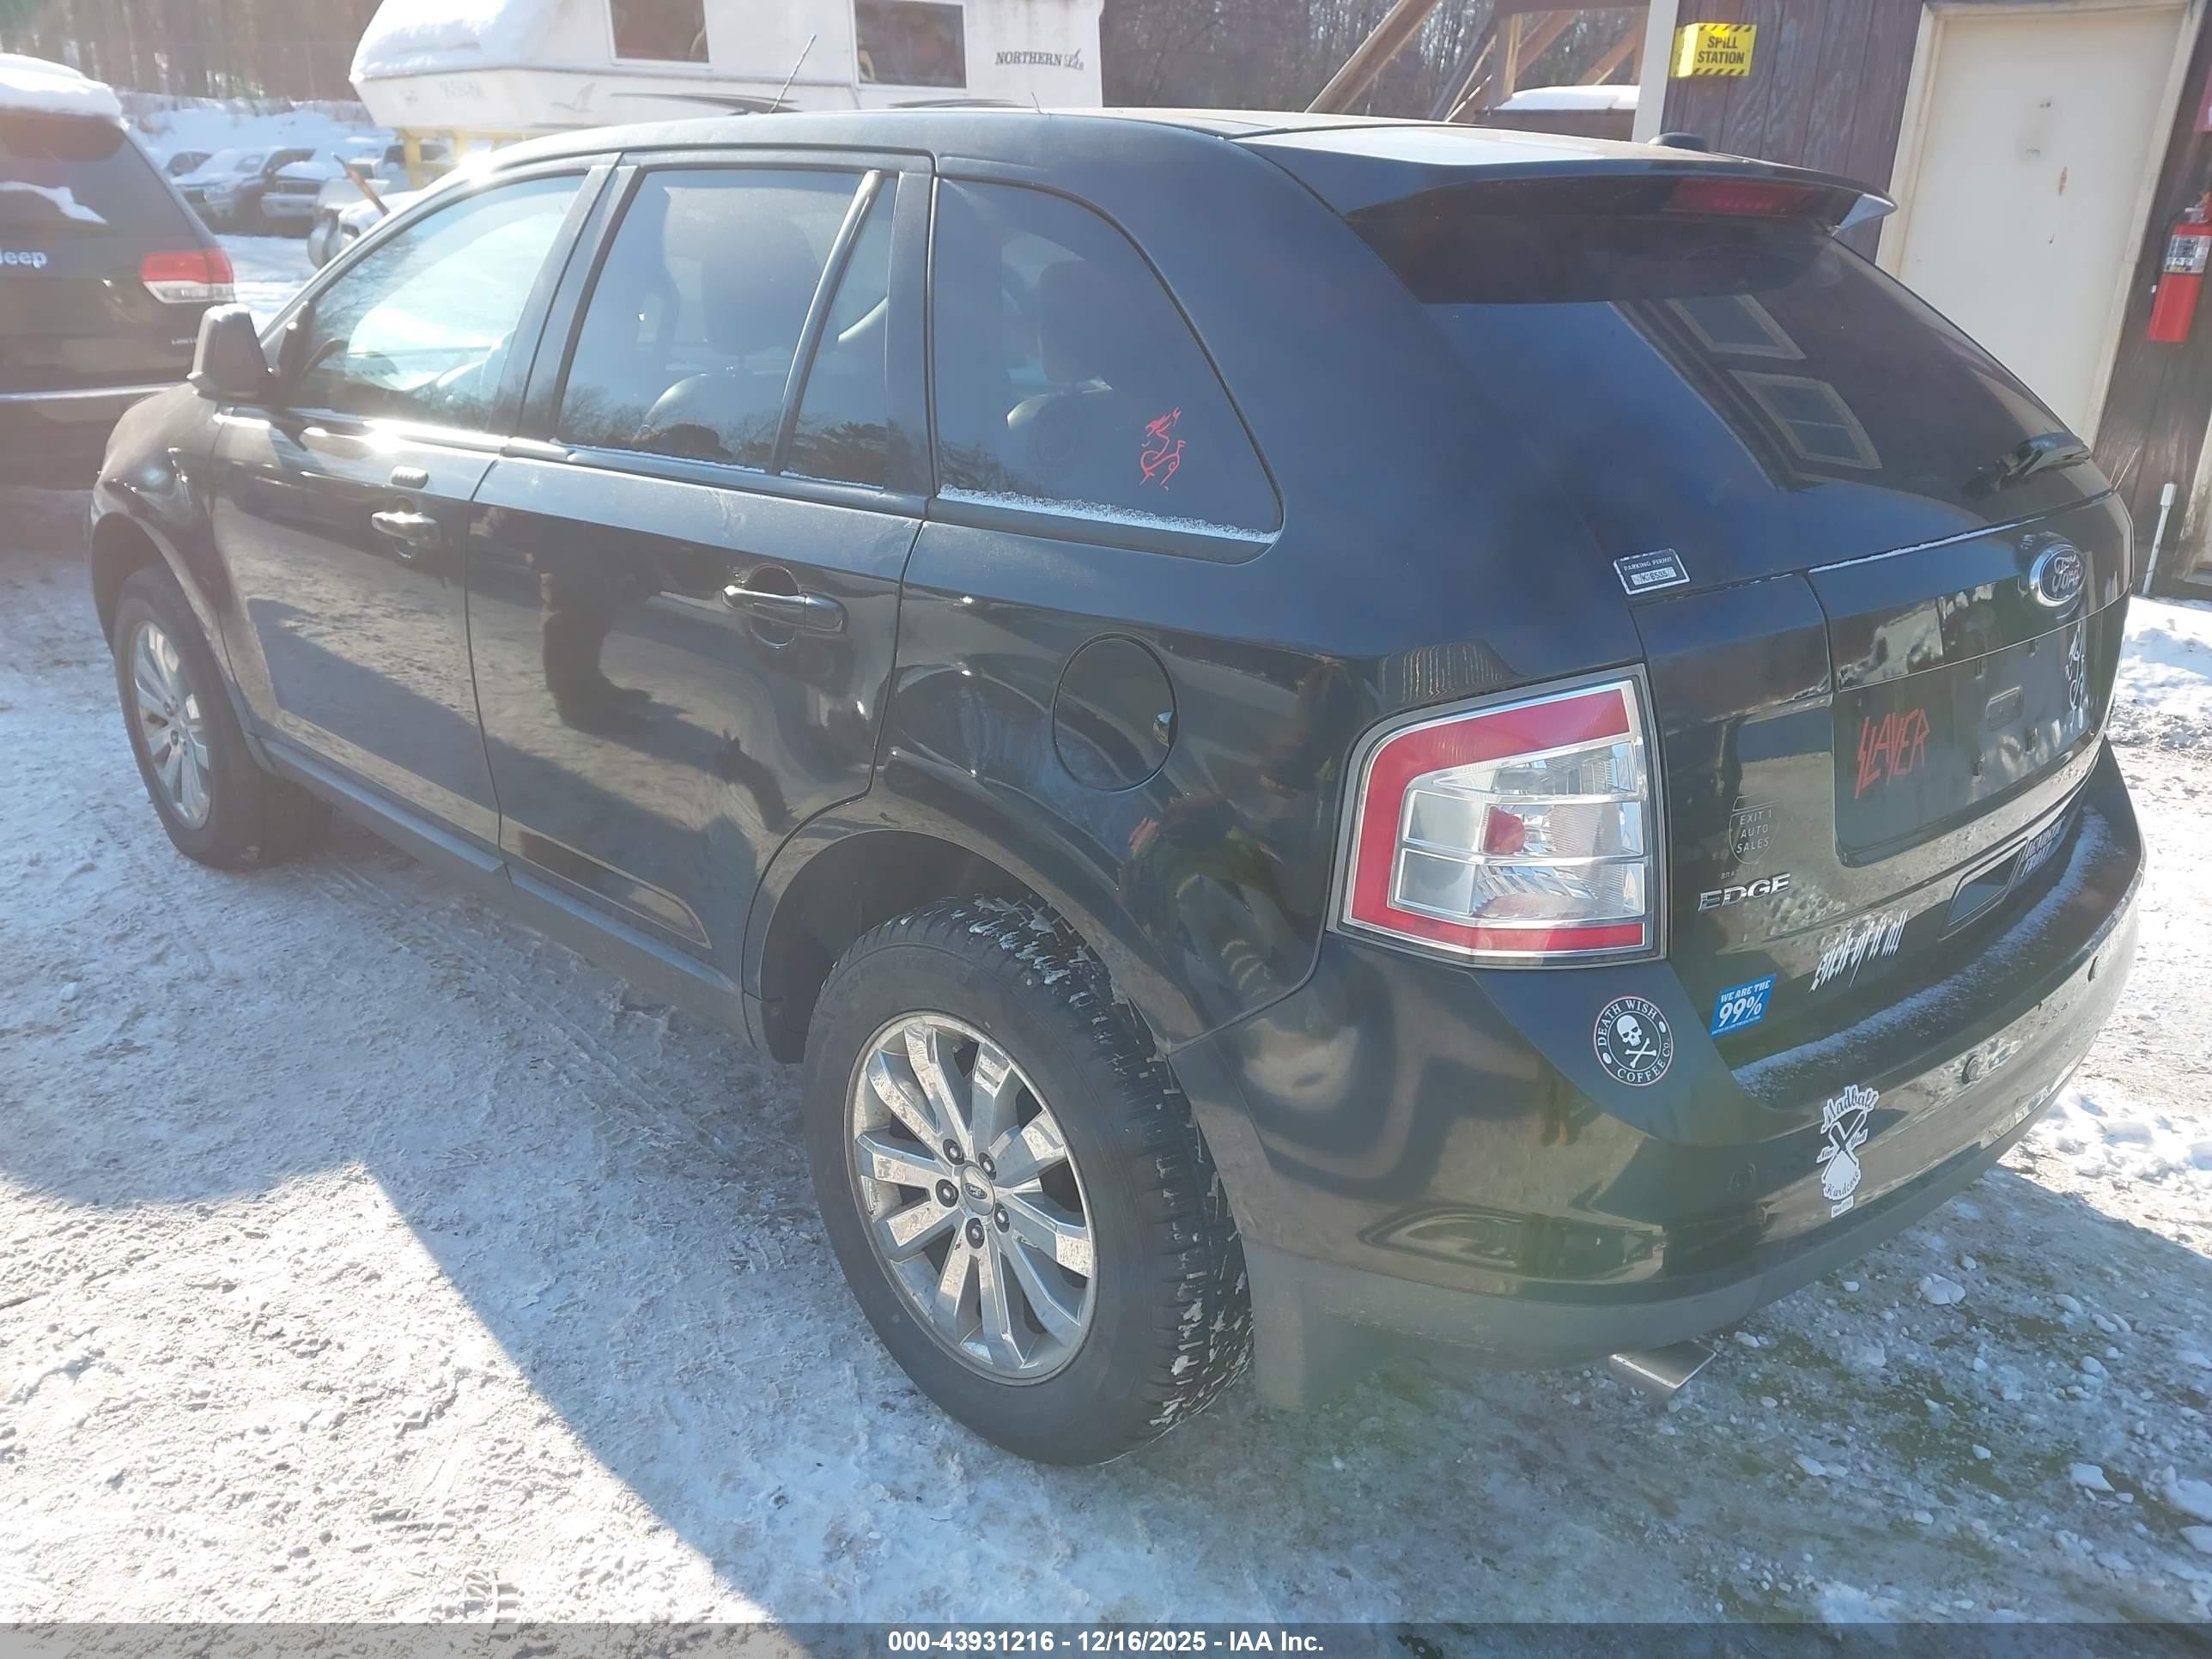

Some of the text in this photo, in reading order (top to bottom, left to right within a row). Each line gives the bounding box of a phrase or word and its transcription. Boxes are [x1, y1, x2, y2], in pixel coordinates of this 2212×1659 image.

[1707, 36, 1738, 49] SPILL
[995, 51, 1061, 66] NORTHERN
[1698, 51, 1745, 64] STATION
[0, 251, 46, 269] eep
[1623, 556, 1673, 572] PARKING PERMIT
[2051, 554, 2082, 593] Ford
[1855, 707, 1930, 799] SLAYER
[1739, 811, 1765, 825] EXIT
[1740, 823, 1769, 839] AUTO
[1736, 836, 1770, 854] SALES
[1698, 872, 1791, 912] EDGE
[1720, 980, 1771, 1003] WE ARE THE
[1718, 992, 1764, 1028] 99%
[1597, 1000, 1658, 1047] DEATH WISH
[1617, 1059, 1666, 1083] COFFEE
